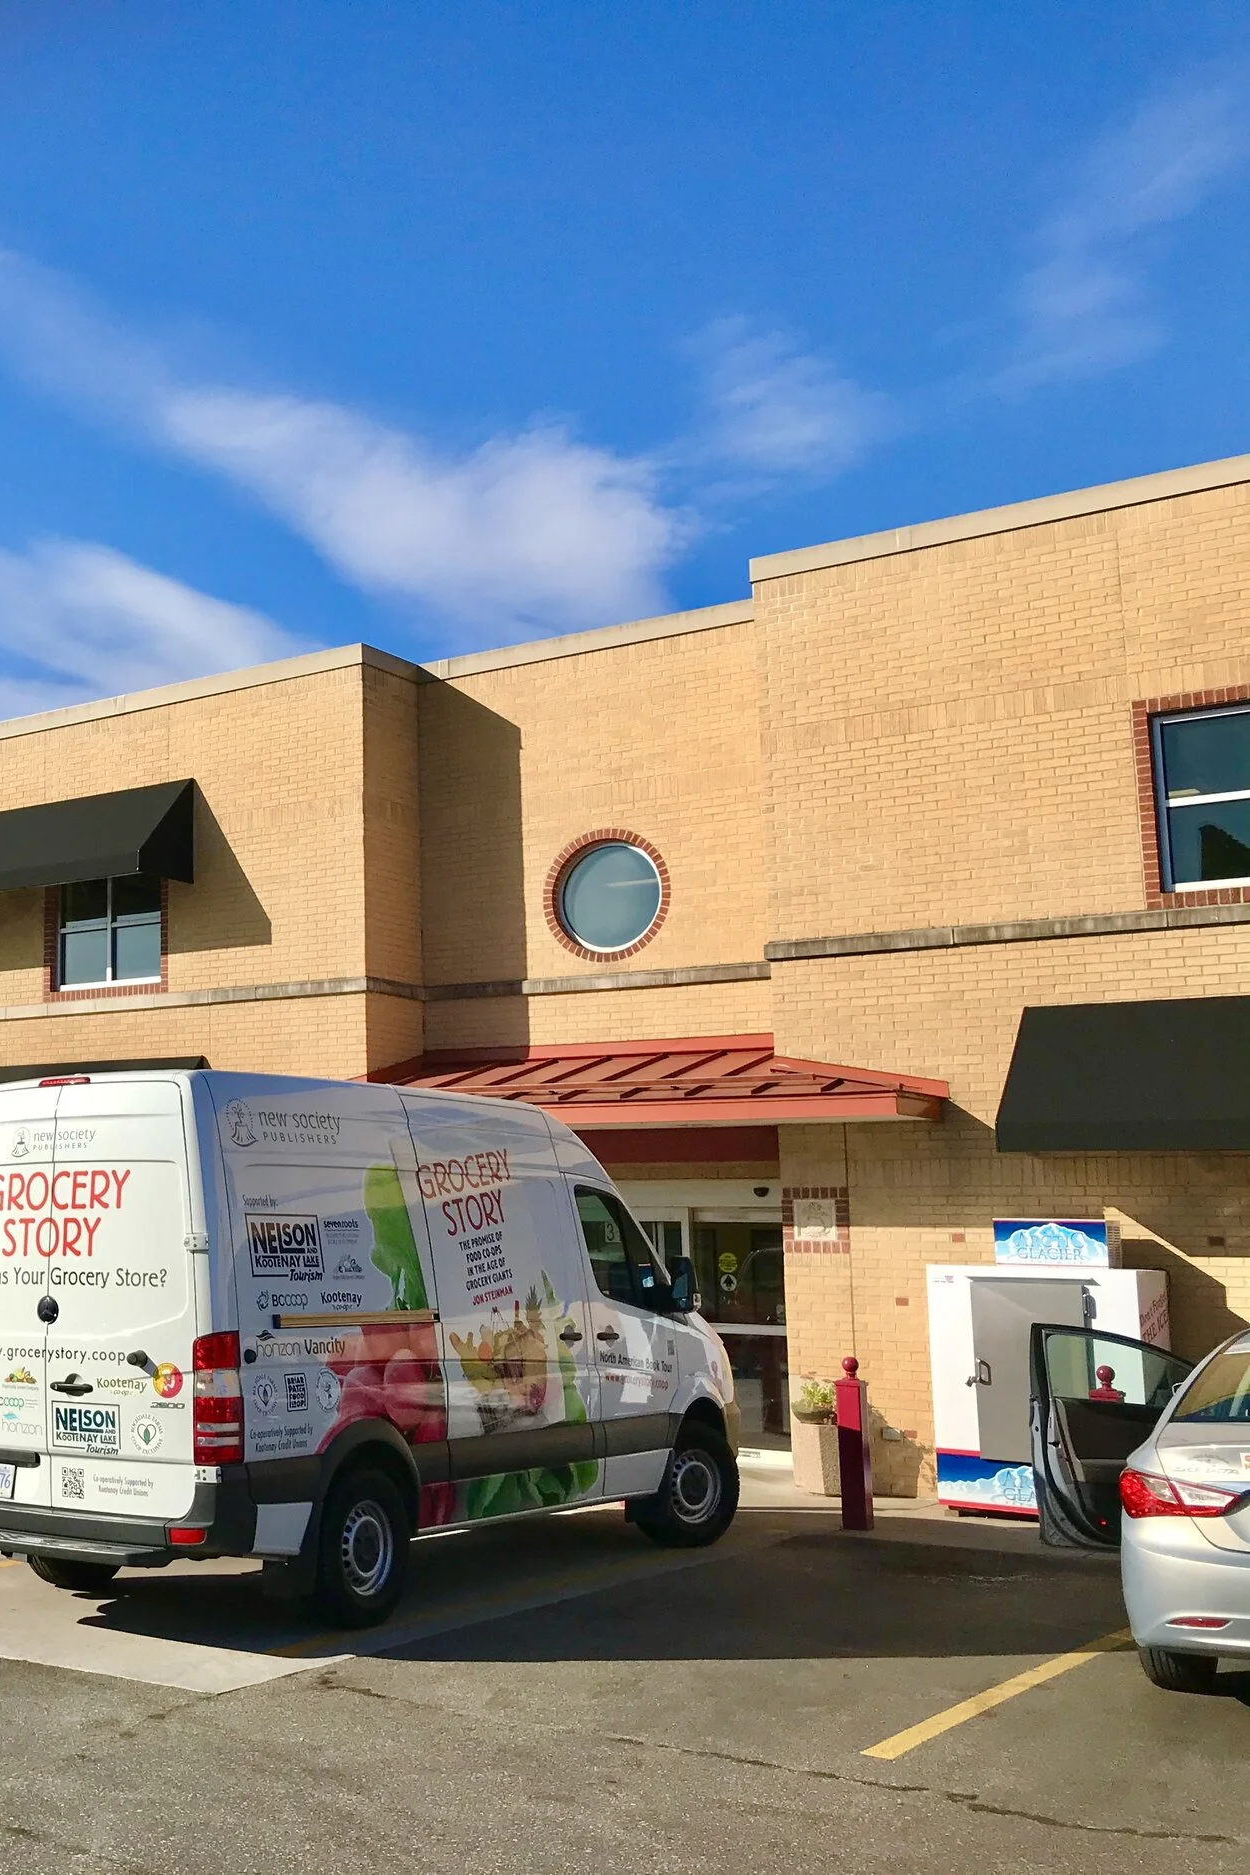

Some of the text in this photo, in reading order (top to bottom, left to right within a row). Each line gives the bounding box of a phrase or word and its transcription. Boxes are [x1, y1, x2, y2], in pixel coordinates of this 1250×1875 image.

[258, 1110, 341, 1135] new society
[33, 1128, 96, 1142] new society
[262, 1131, 337, 1145] PUBLISHERS
[32, 1142, 88, 1150] PUBLISHERS
[418, 1148, 511, 1199] GROCERY
[442, 1188, 505, 1237] STORY
[1, 1216, 101, 1257] STORY
[250, 1222, 317, 1254] NELSON
[459, 1231, 503, 1251] THE PROMISE OF
[1016, 1231, 1085, 1248] ARCTIC
[255, 1255, 320, 1268] KOOTENAY LAKE
[466, 1249, 482, 1263] FOOD
[1017, 1247, 1087, 1260] GLACIER
[474, 1263, 486, 1275] THE
[486, 1259, 498, 1271] AGE
[498, 1257, 506, 1268] OF
[14, 1267, 45, 1285] Your
[50, 1268, 110, 1288] Grocery
[115, 1268, 168, 1288] Store?
[290, 1269, 323, 1282] Tourism
[466, 1268, 513, 1291] GROCERY GIANTS
[320, 1291, 362, 1307] Kootenay
[473, 1284, 513, 1306] JON STEINMAN
[304, 1336, 346, 1357] Vancity
[599, 1351, 616, 1364] North
[645, 1358, 661, 1371] Book
[662, 1360, 672, 1373] Tour
[96, 1378, 147, 1394] Kootenay
[55, 1407, 116, 1433] NELSON
[56, 1431, 117, 1444] KOOTENAY LAKE
[86, 1443, 119, 1455] Tourism
